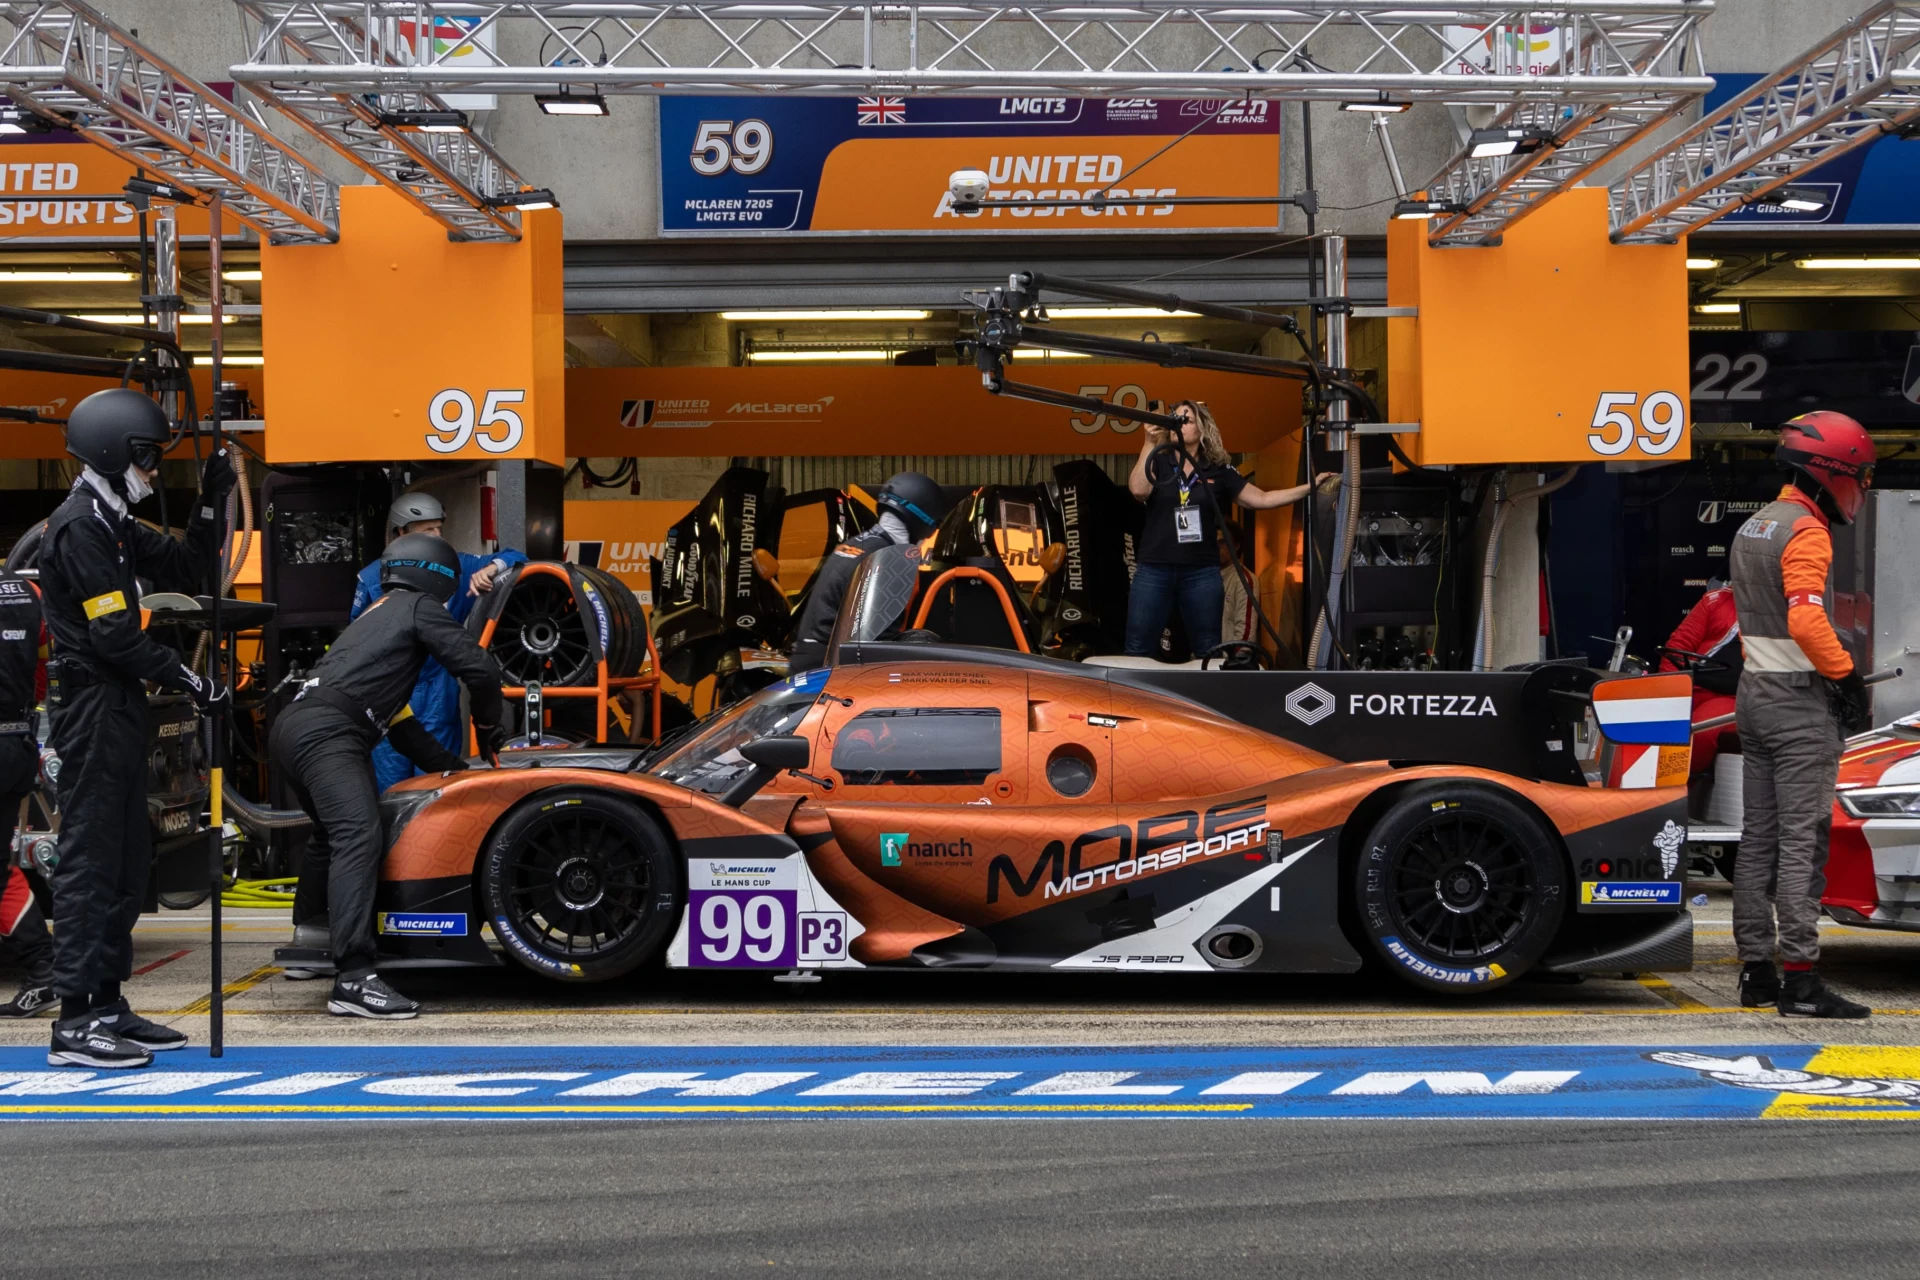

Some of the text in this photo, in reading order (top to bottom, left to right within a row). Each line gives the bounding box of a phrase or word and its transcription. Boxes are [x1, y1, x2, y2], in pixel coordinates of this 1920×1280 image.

[1216, 116, 1231, 124] LE
[690, 118, 773, 176] 59
[988, 155, 1123, 184] UNITED
[685, 199, 774, 210] MCLAREN 720S
[696, 211, 763, 222] LMGT3 EVO
[933, 188, 1177, 218] ATOSPORTS
[1690, 353, 1768, 400] 22
[658, 399, 710, 408] UNITED
[726, 402, 822, 413] McLaren
[1070, 384, 1148, 435] 59
[425, 388, 527, 454] 95
[1587, 390, 1685, 456] 59
[737, 493, 757, 598] RICHARD MILLE
[1064, 485, 1083, 591] RICHARD MILLE
[662, 537, 677, 589] BLAUPUNKT
[1350, 694, 1498, 716] FORTEZZA
[885, 838, 973, 862] fynanch
[1044, 822, 1270, 899] MOTORSPORT
[711, 879, 771, 887] LE MANS CUP
[1579, 858, 1662, 879] sonic
[1611, 889, 1670, 897] MICHELIN
[398, 920, 455, 929] MICHELIN
[699, 895, 786, 962] 99
[801, 918, 843, 954] P3
[500, 920, 557, 968] MICHELIN
[1126, 955, 1184, 963] P320
[1388, 941, 1472, 982] MICHELIN
[0, 1070, 1581, 1098] MICHELIN
